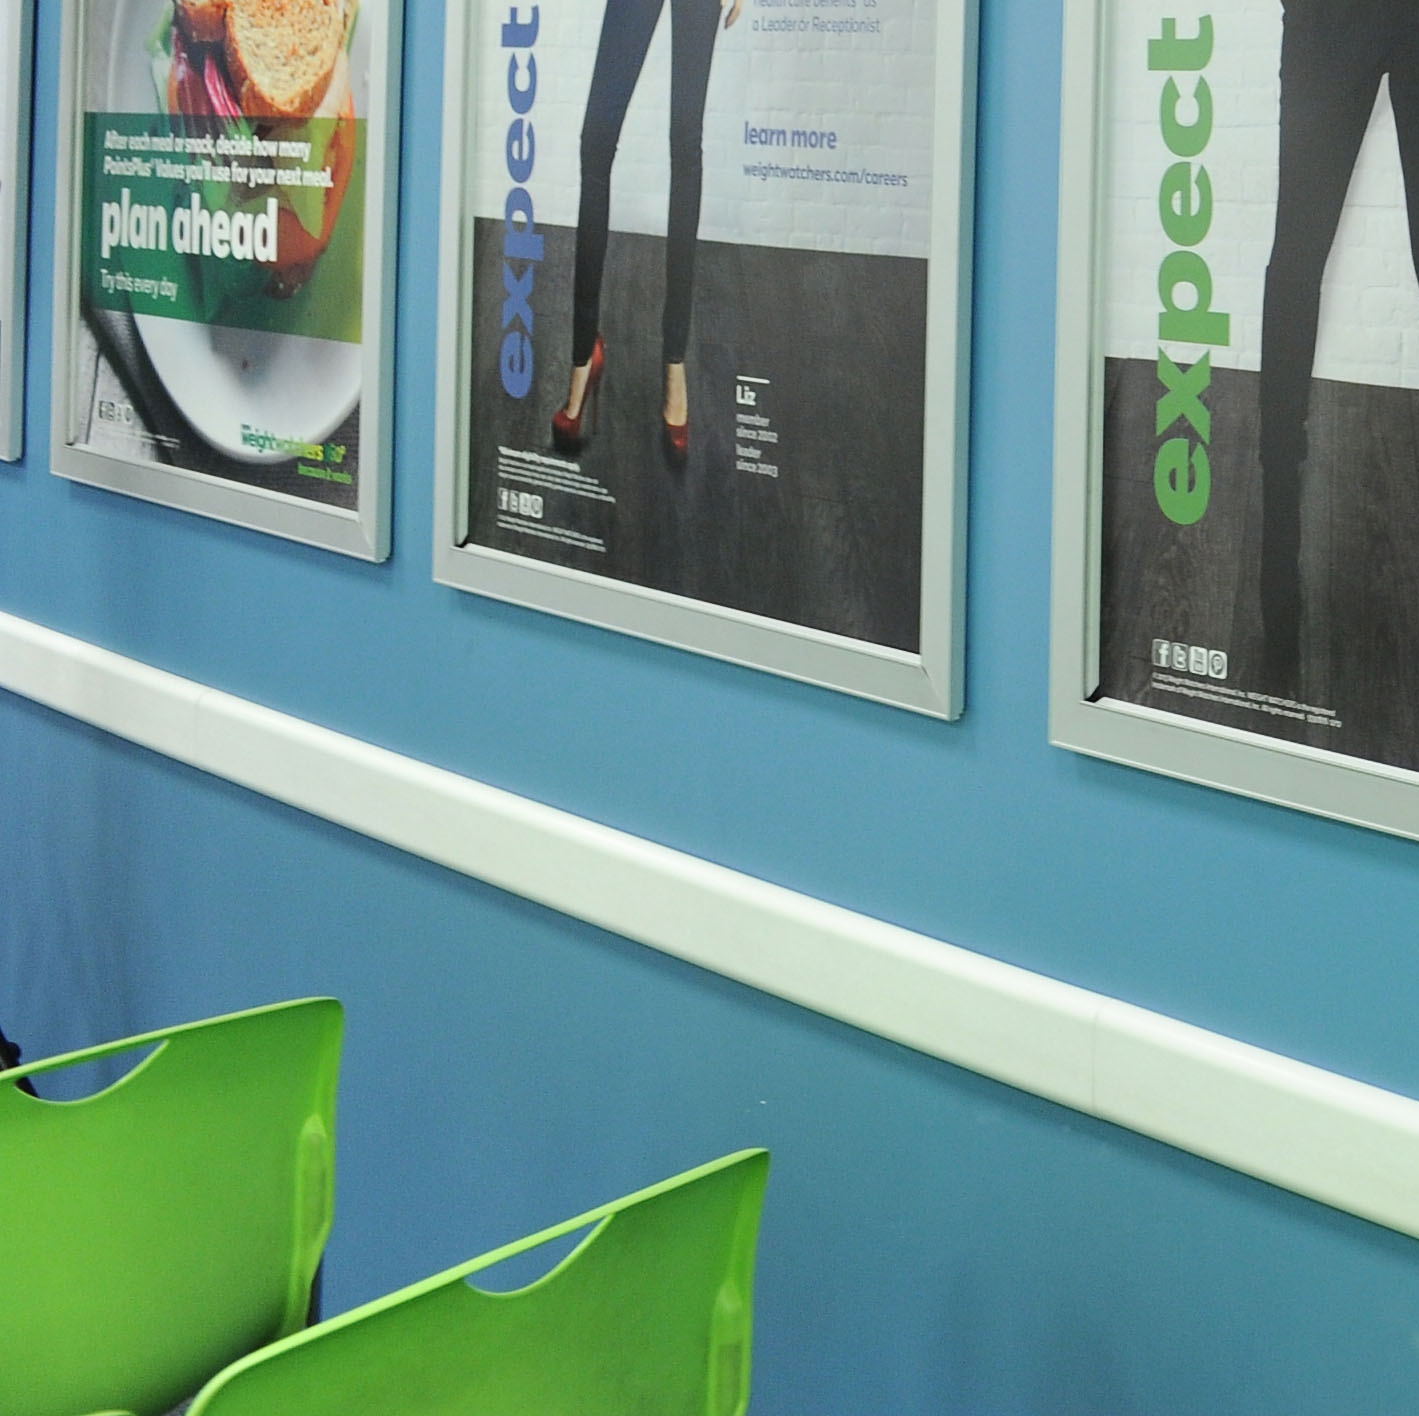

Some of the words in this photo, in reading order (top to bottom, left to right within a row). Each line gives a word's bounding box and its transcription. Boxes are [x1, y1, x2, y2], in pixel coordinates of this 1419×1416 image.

[744, 121, 787, 146] learn
[791, 128, 837, 149] more
[742, 161, 908, 187] weightwatchers.com/careers
[101, 187, 168, 259] plan
[171, 192, 278, 262] ahead
[500, 5, 544, 399] expect
[100, 269, 115, 293] Try
[159, 278, 178, 301] day
[1147, 14, 1230, 526] expect
